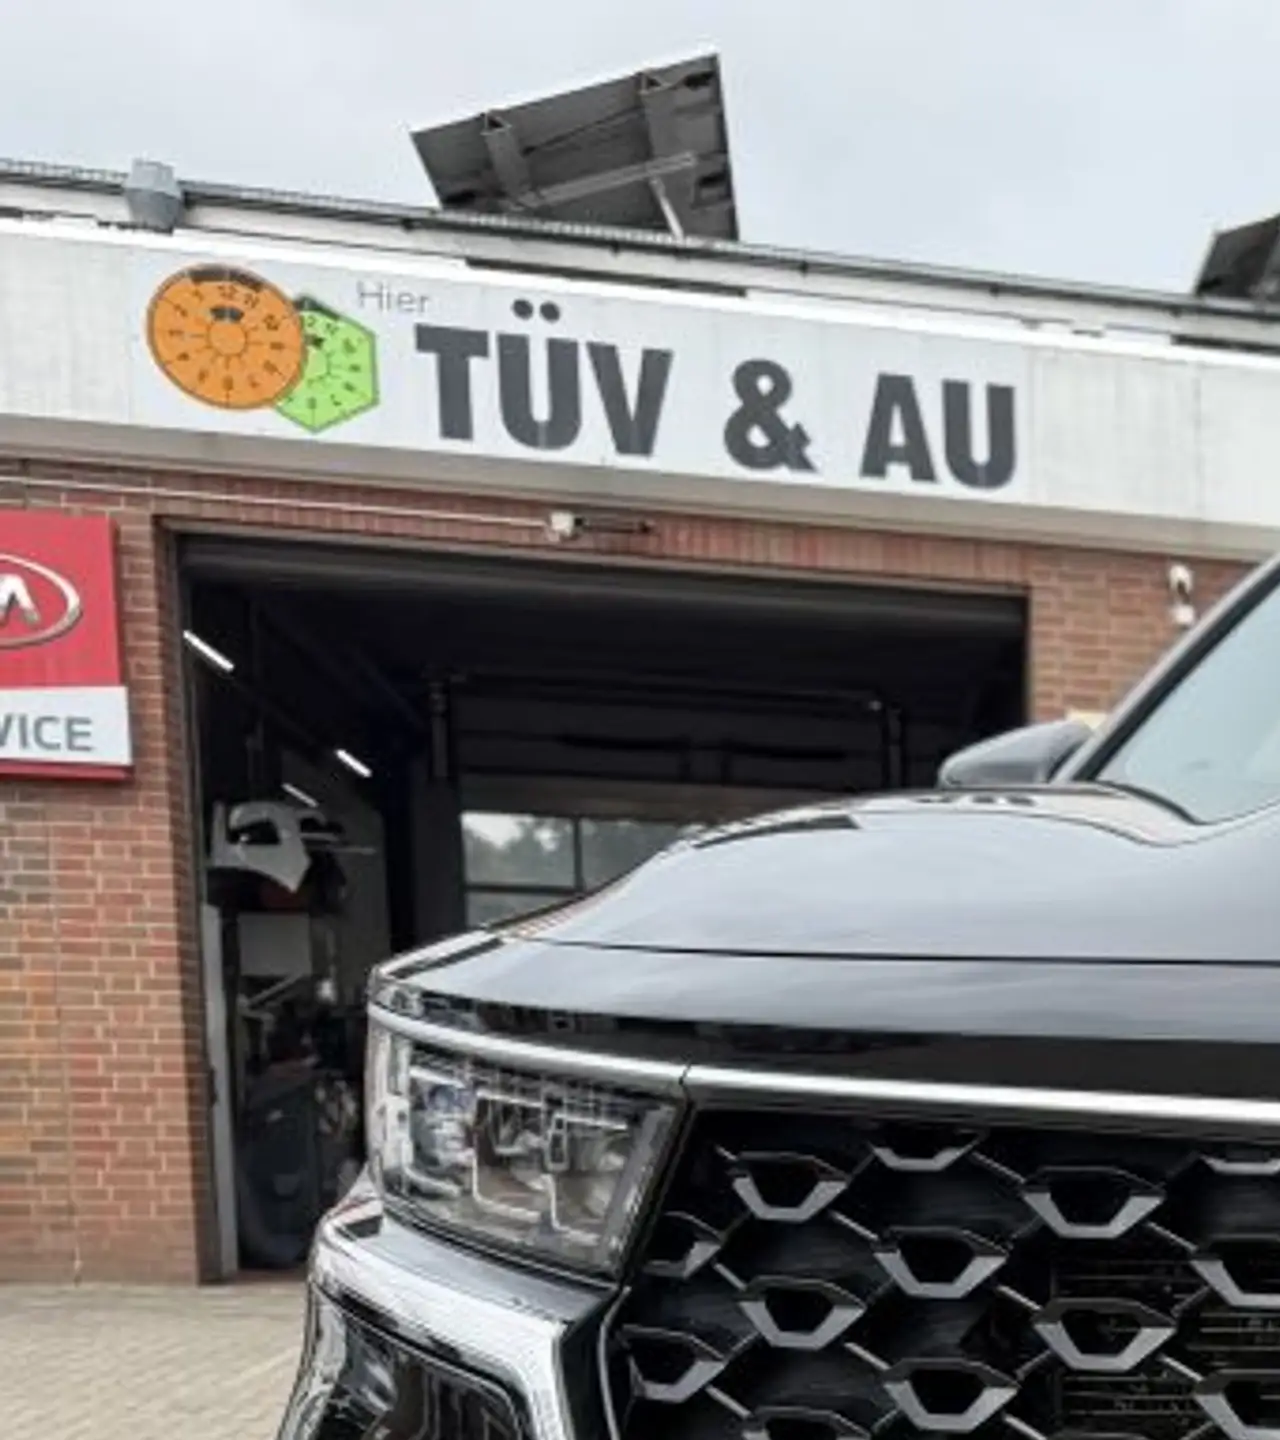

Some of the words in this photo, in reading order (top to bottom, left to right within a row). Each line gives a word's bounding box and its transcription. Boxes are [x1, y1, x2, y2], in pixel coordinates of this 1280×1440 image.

[356, 279, 430, 314] Hier
[414, 298, 674, 458] TÜV
[723, 358, 820, 473] &
[858, 371, 1016, 490] AU
